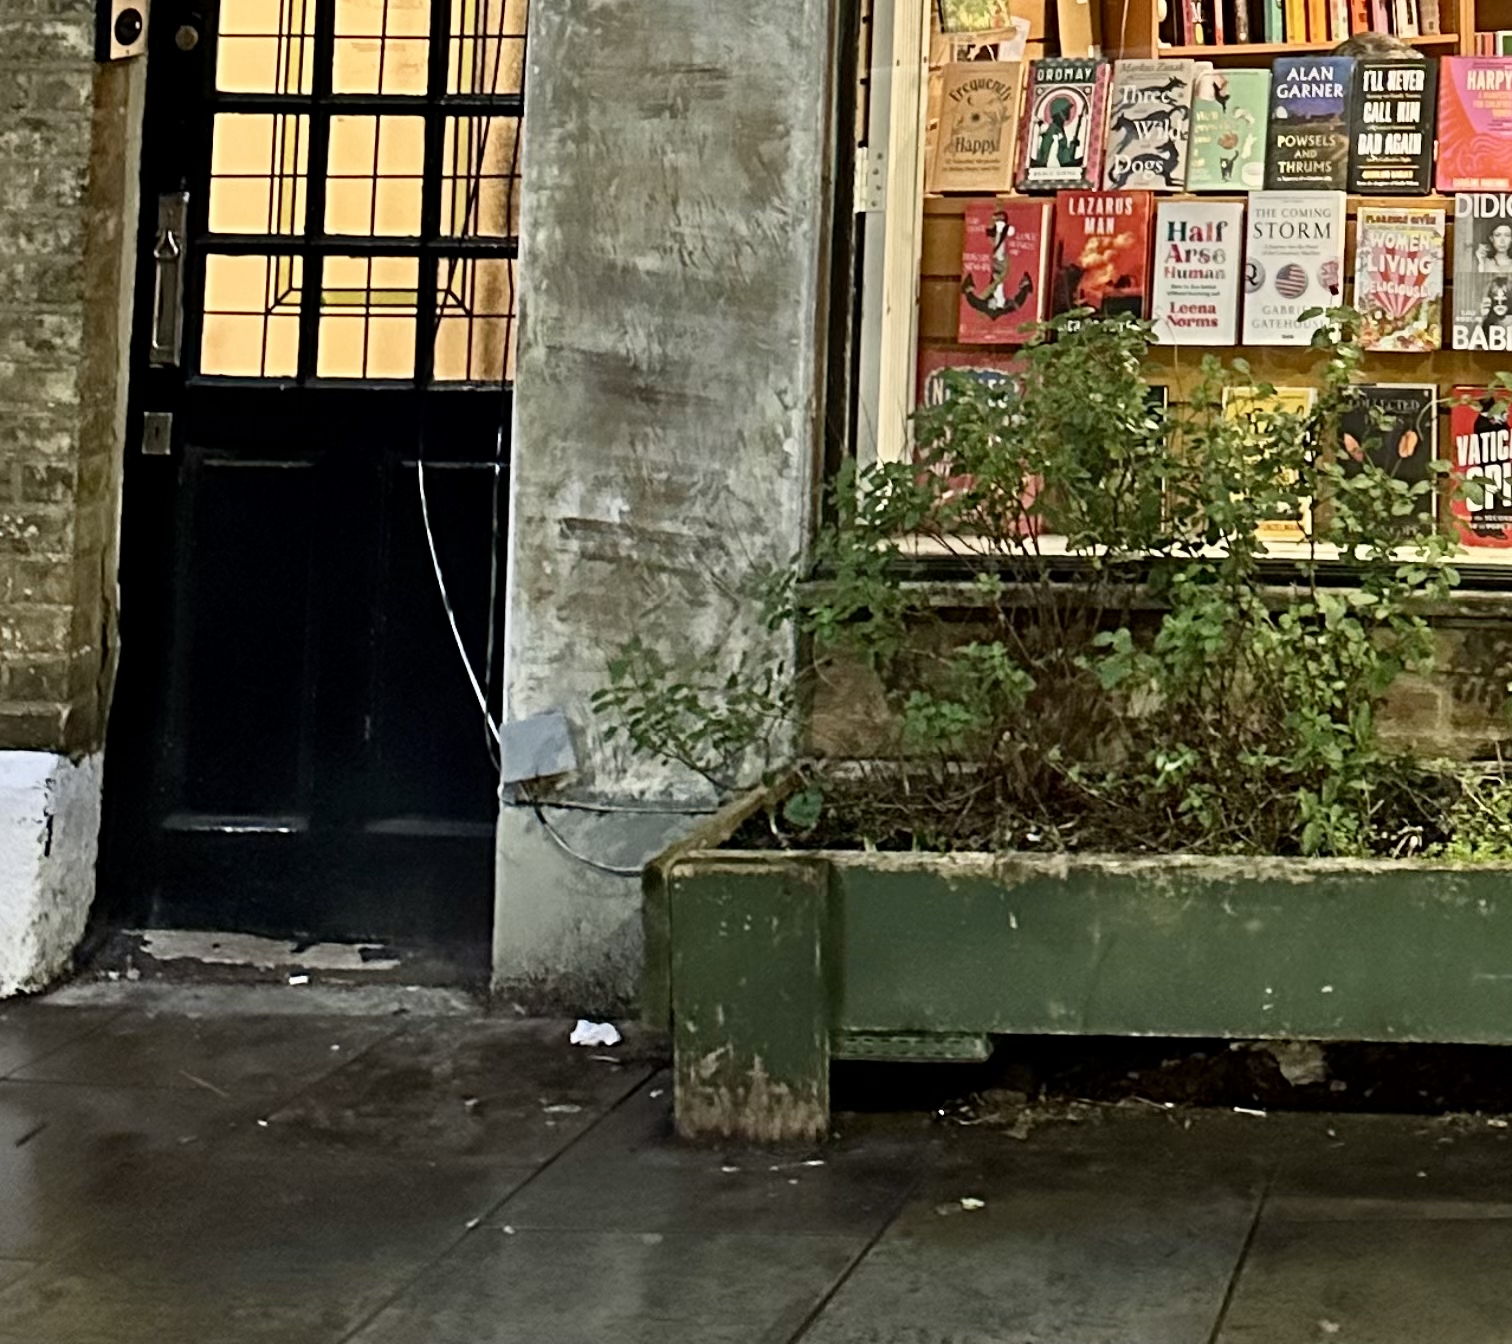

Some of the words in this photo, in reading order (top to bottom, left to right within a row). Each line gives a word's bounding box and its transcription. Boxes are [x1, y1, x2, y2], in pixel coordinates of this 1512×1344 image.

[1036, 68, 1093, 82] OROMAY
[1286, 65, 1334, 81] ALAN
[1362, 70, 1384, 92] I'LL
[1387, 70, 1425, 91] NEVER
[1121, 84, 1171, 105] Three
[1276, 83, 1344, 99] GARNER
[1363, 101, 1392, 123] CALL
[955, 136, 997, 156] Happy
[1277, 134, 1337, 148] POWSELS
[1384, 132, 1423, 155] AGAIN
[1294, 149, 1318, 159] AND
[1113, 154, 1165, 180] Dogs
[1277, 160, 1332, 174] THRUMS
[1068, 196, 1134, 216] LAZARUS
[1255, 208, 1277, 218] THE
[1280, 208, 1332, 219] COMING
[1084, 216, 1115, 235] MAN
[1167, 220, 1229, 243] Half
[1252, 221, 1332, 240] STORM
[1368, 233, 1431, 252] WOMEN
[1163, 243, 1227, 264] Arse
[1163, 265, 1227, 280] Human
[1366, 254, 1432, 277] LIVING
[1169, 301, 1217, 315] Leena
[1166, 314, 1219, 328] Norms
